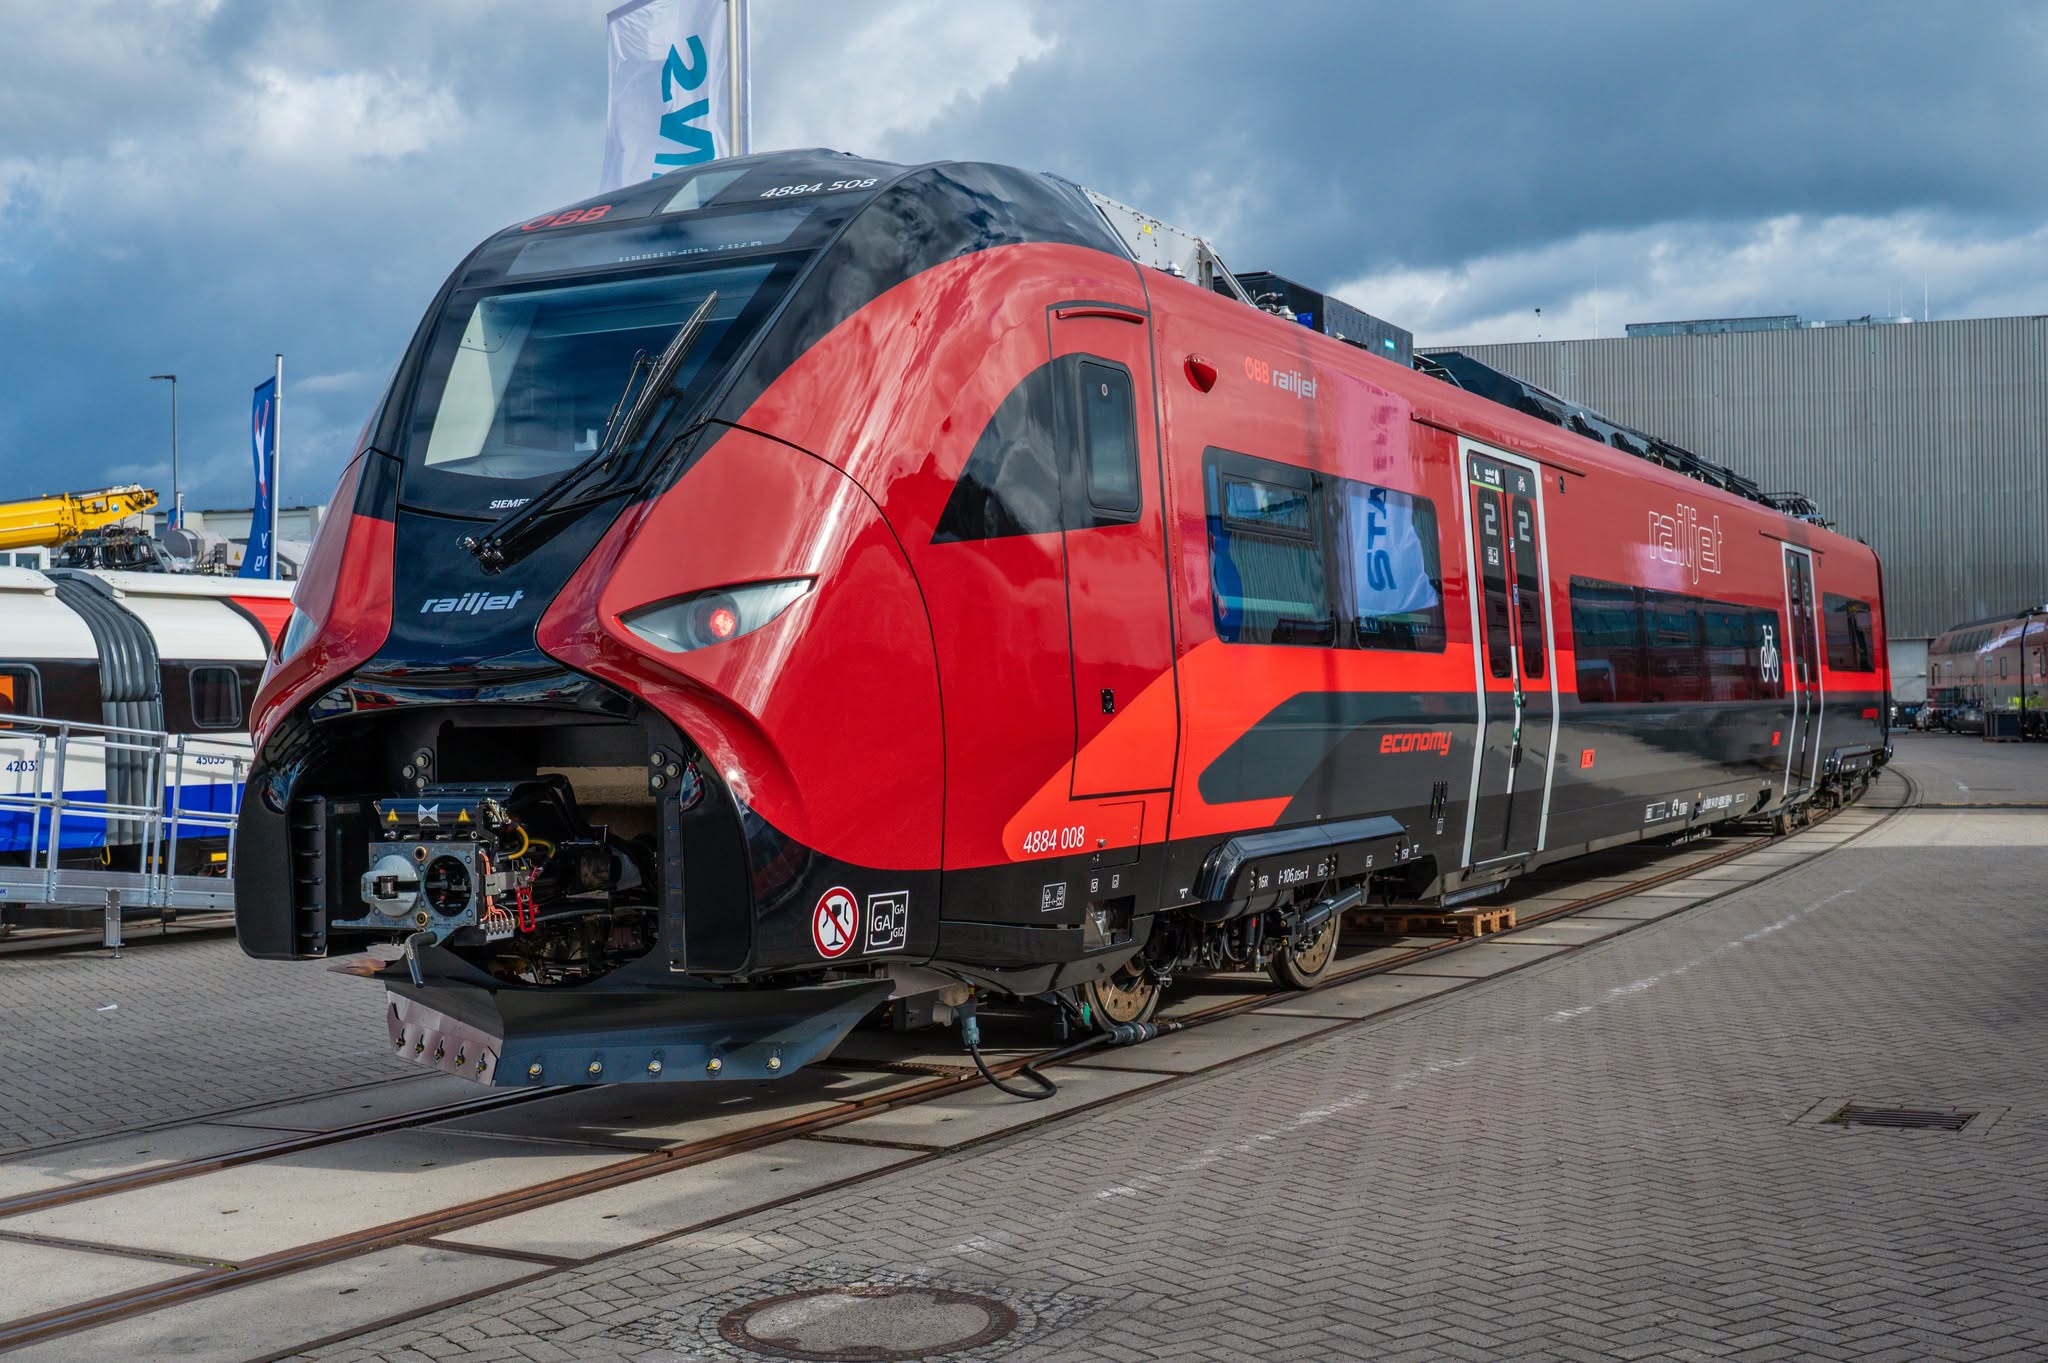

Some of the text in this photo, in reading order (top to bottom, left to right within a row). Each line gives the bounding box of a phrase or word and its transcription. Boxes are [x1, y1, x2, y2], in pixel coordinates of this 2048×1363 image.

[760, 178, 878, 200] 4884 508
[1273, 369, 1318, 399] railjet
[489, 498, 530, 509] SIEME
[1483, 502, 1497, 536] 2
[1517, 510, 1530, 542] 2
[1648, 503, 1723, 585] railjet
[420, 590, 524, 616] railjet
[1379, 731, 1452, 756] economy
[1022, 825, 1085, 854] 4884 008
[894, 904, 905, 915] GA
[874, 914, 891, 932] GA
